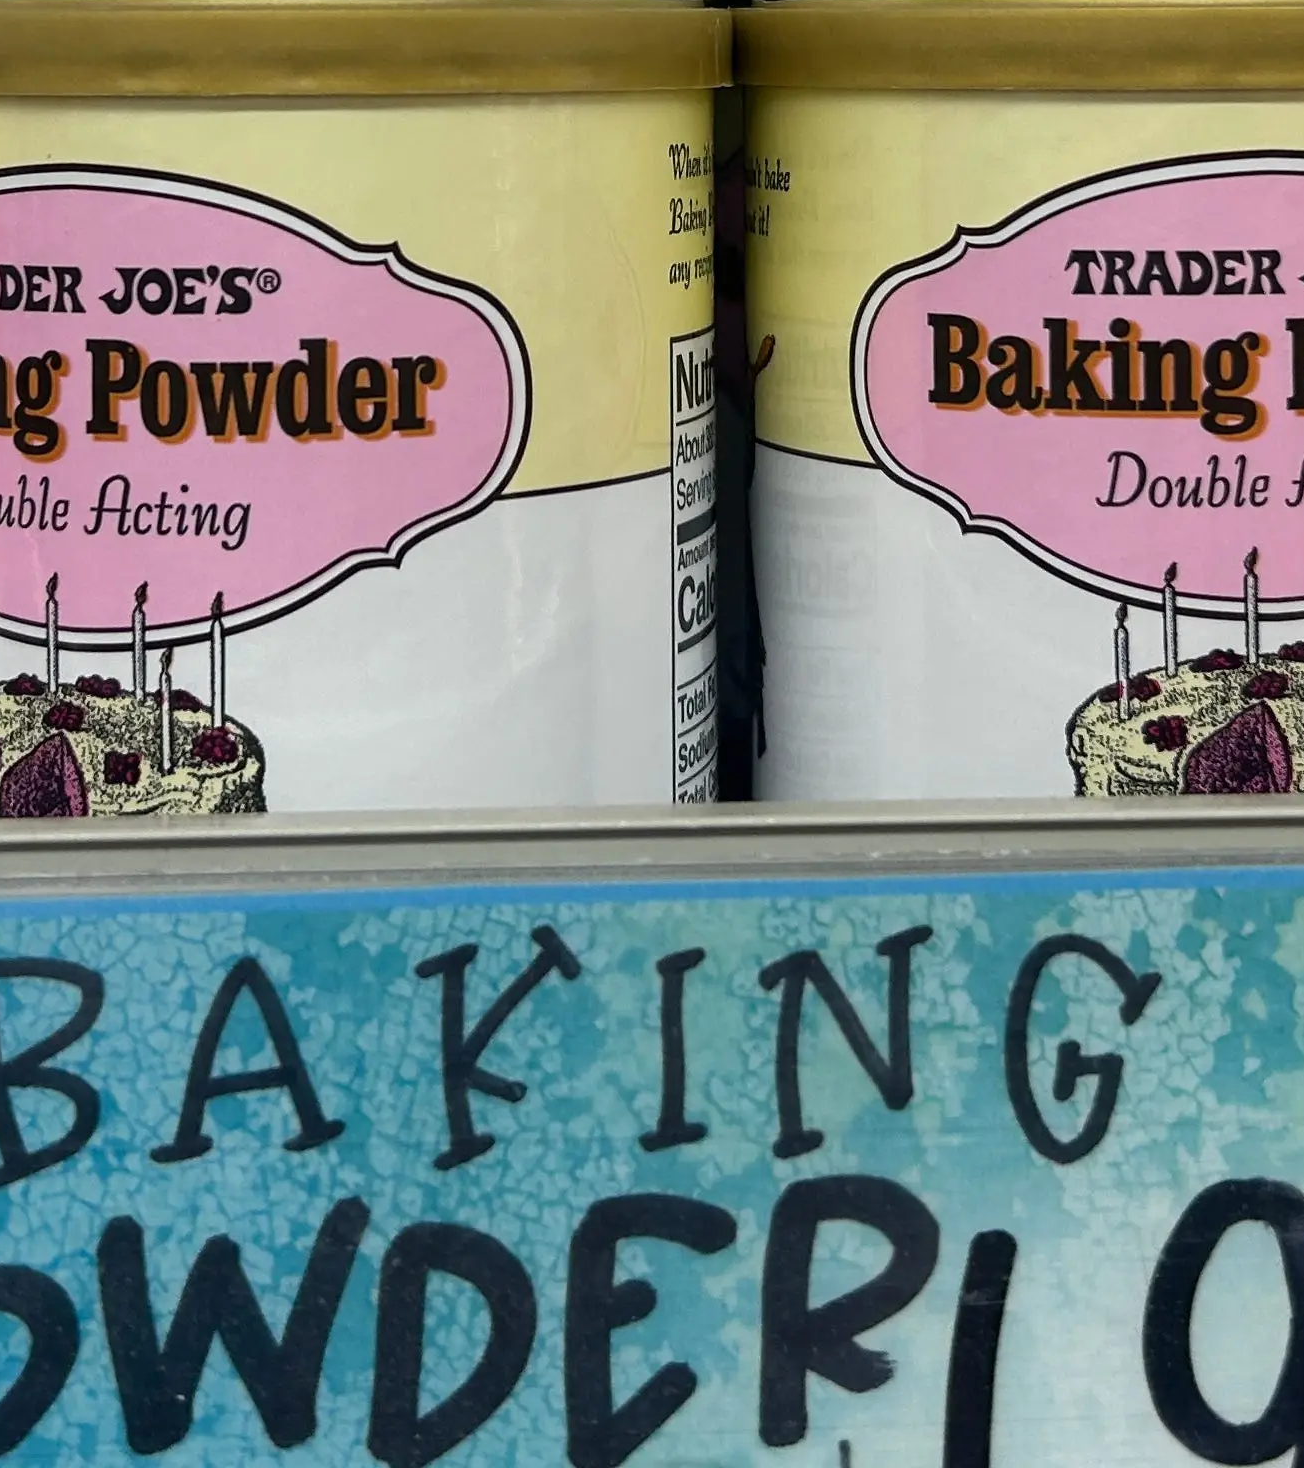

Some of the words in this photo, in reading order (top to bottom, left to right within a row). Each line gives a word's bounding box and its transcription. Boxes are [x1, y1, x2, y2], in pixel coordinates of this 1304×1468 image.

[765, 157, 791, 192] bake
[1064, 249, 1286, 296] TRADER
[85, 337, 445, 443] Powder
[926, 312, 1270, 440] Baking
[84, 474, 252, 551] Acting
[1095, 450, 1271, 510] Double
